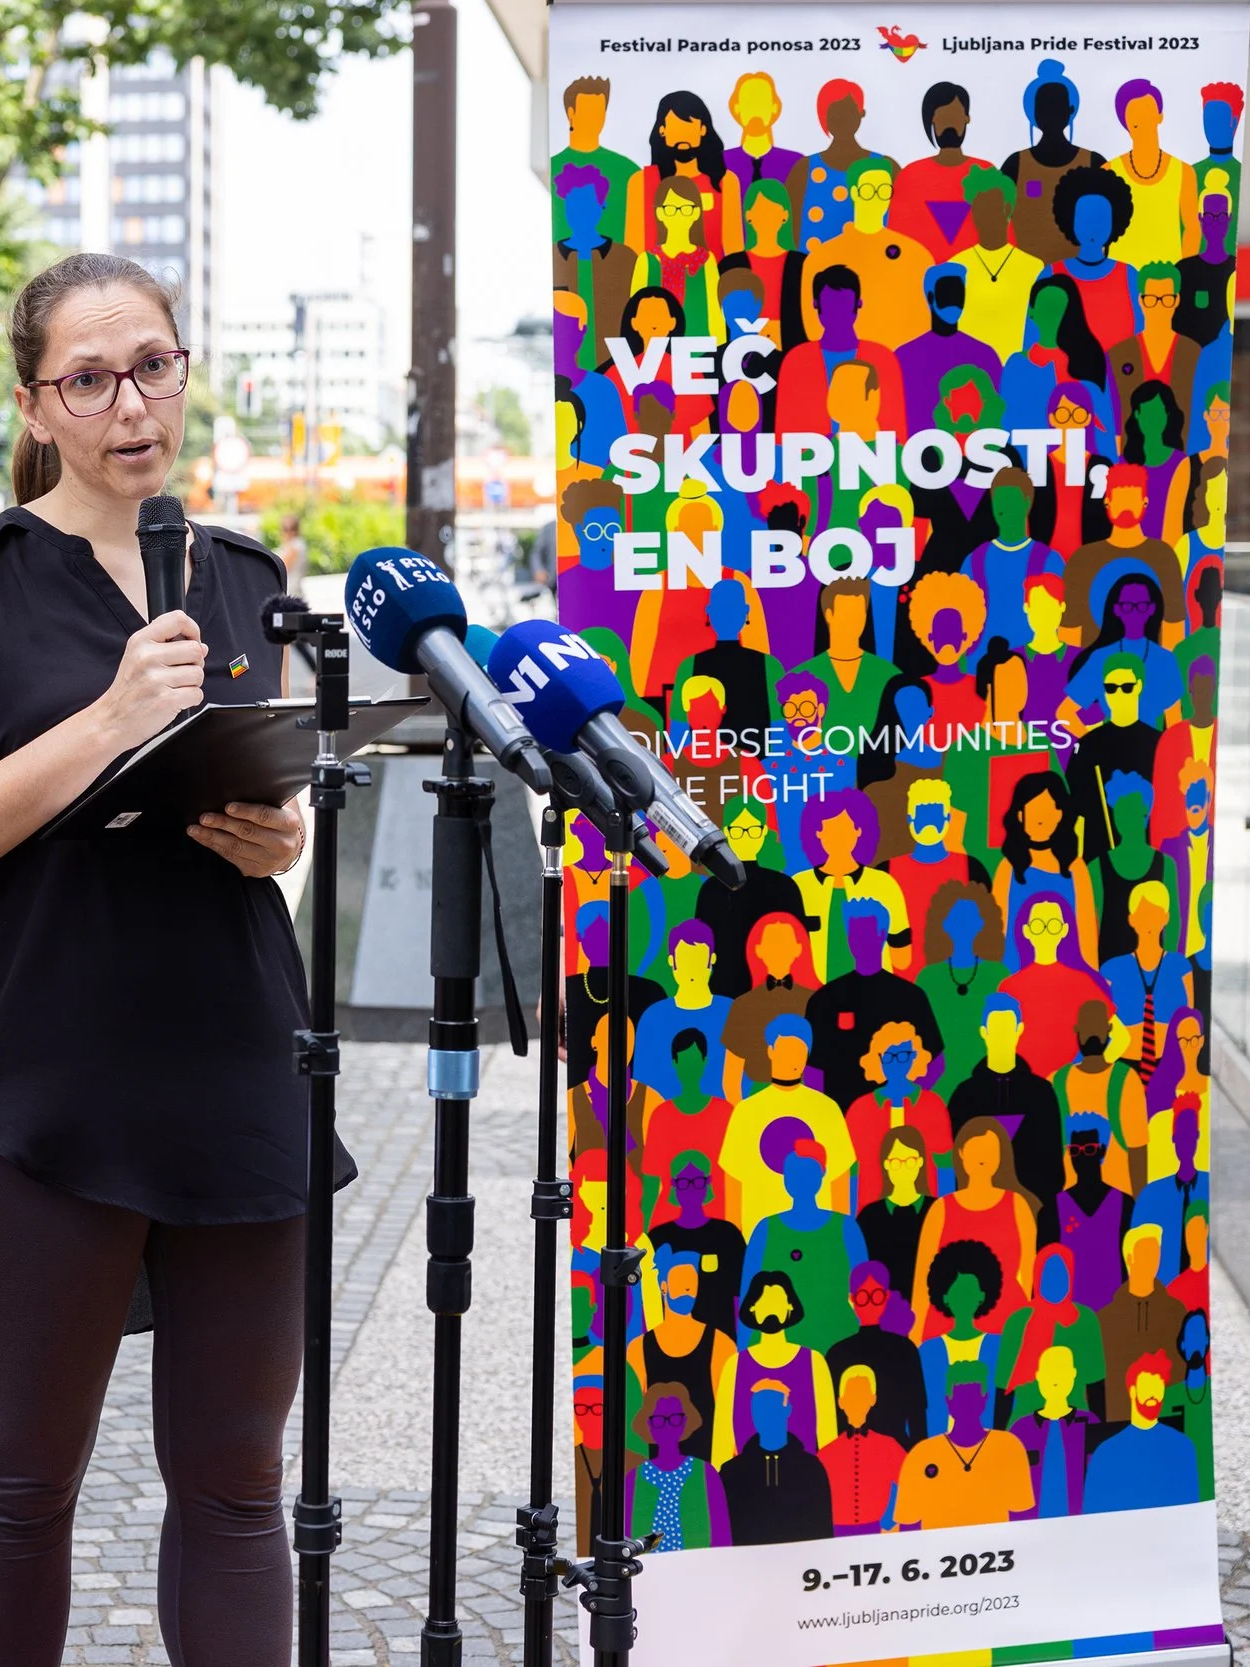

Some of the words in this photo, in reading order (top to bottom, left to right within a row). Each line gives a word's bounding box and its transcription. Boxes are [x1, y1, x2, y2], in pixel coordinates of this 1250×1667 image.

[600, 37, 671, 52] Festival
[677, 37, 740, 52] Parada
[747, 40, 813, 54] ponosa
[819, 38, 861, 51] 2023
[942, 36, 1025, 54] Ljubljana
[1030, 36, 1077, 50] Pride
[1083, 36, 1152, 50] Festival
[1158, 37, 1200, 50] 2023
[604, 318, 777, 396] VEČ
[608, 426, 1110, 499] SKUPNOSTI,
[399, 557, 436, 569] RTV
[613, 531, 723, 591] EN
[751, 526, 916, 589] BOJ
[412, 570, 451, 583] SLO
[352, 575, 373, 617] RTV
[362, 589, 386, 631] SLO
[324, 648, 348, 659] RØDE
[797, 719, 1080, 755] COMMUNITIES,
[719, 772, 834, 805] FIGHT
[901, 1559, 930, 1582] 6.
[939, 1550, 1015, 1578] 2023
[797, 1595, 1020, 1630] www.ljubljanapride.org/2023
